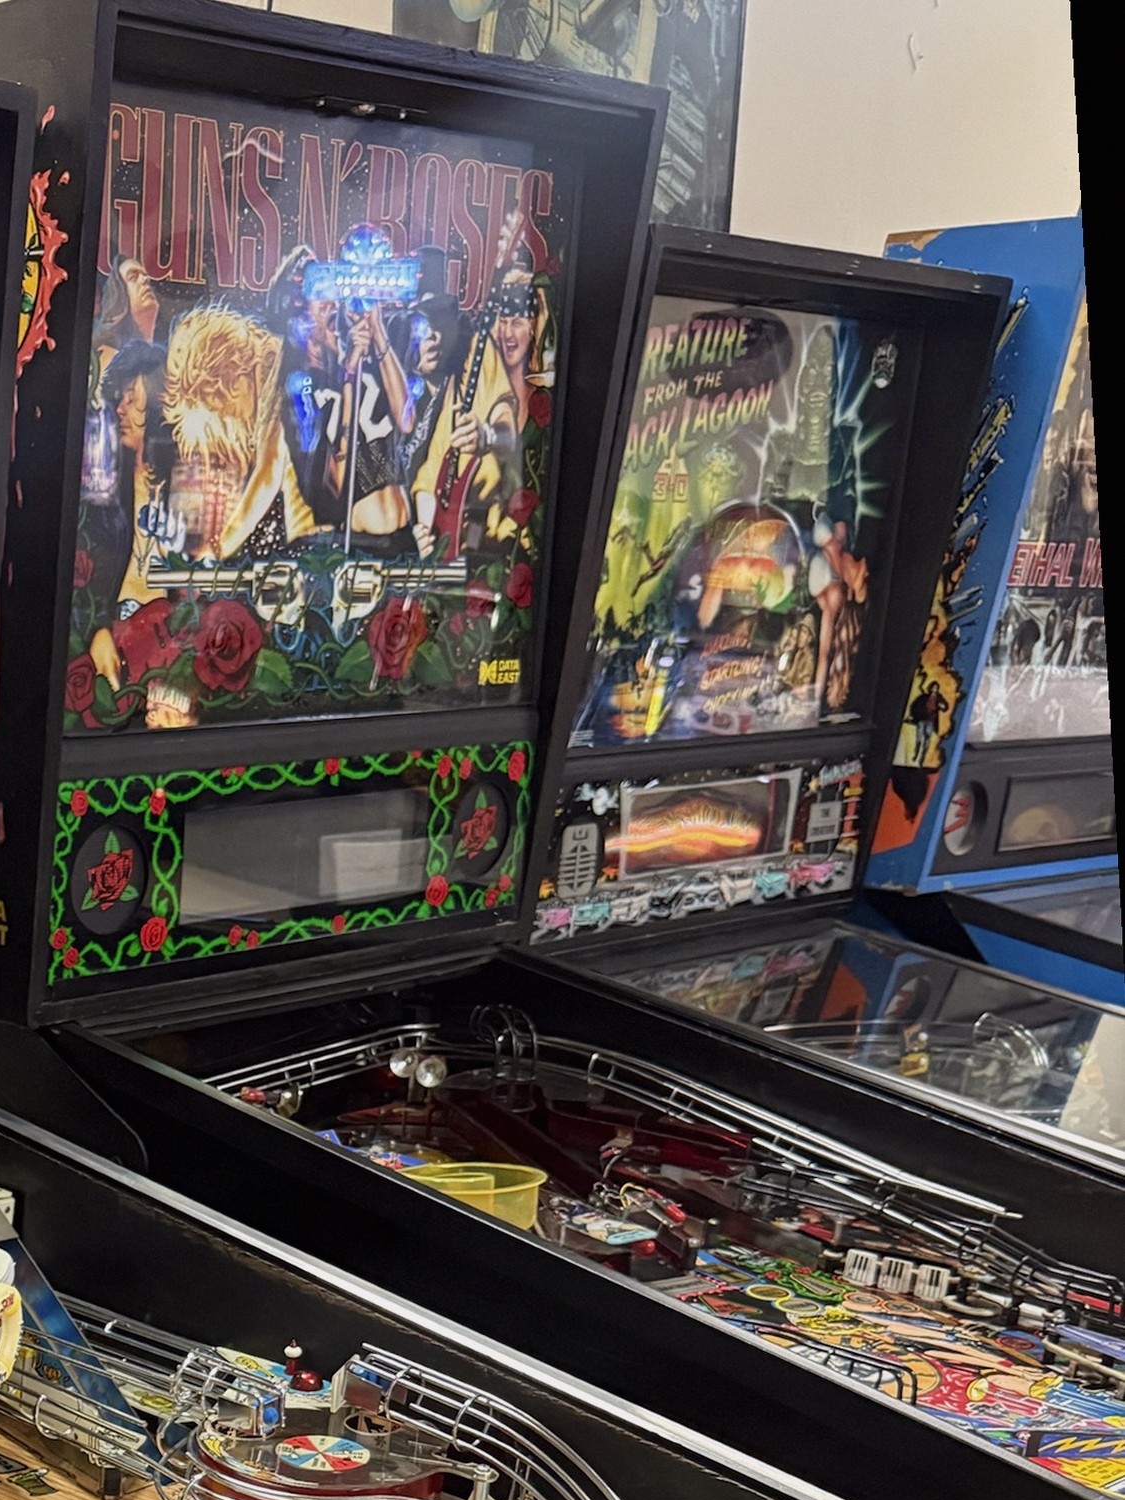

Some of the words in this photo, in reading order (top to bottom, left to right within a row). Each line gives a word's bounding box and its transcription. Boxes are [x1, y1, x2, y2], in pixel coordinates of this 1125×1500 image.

[96, 102, 285, 293] GUNS
[367, 143, 554, 310] ROSES
[640, 317, 753, 382] REATURE
[643, 379, 688, 415] FROM
[693, 371, 724, 395] THE
[624, 407, 677, 473] ACK
[675, 379, 774, 456] LAGOON
[1007, 541, 1075, 587] ETHAL
[497, 672, 521, 684] EAST
